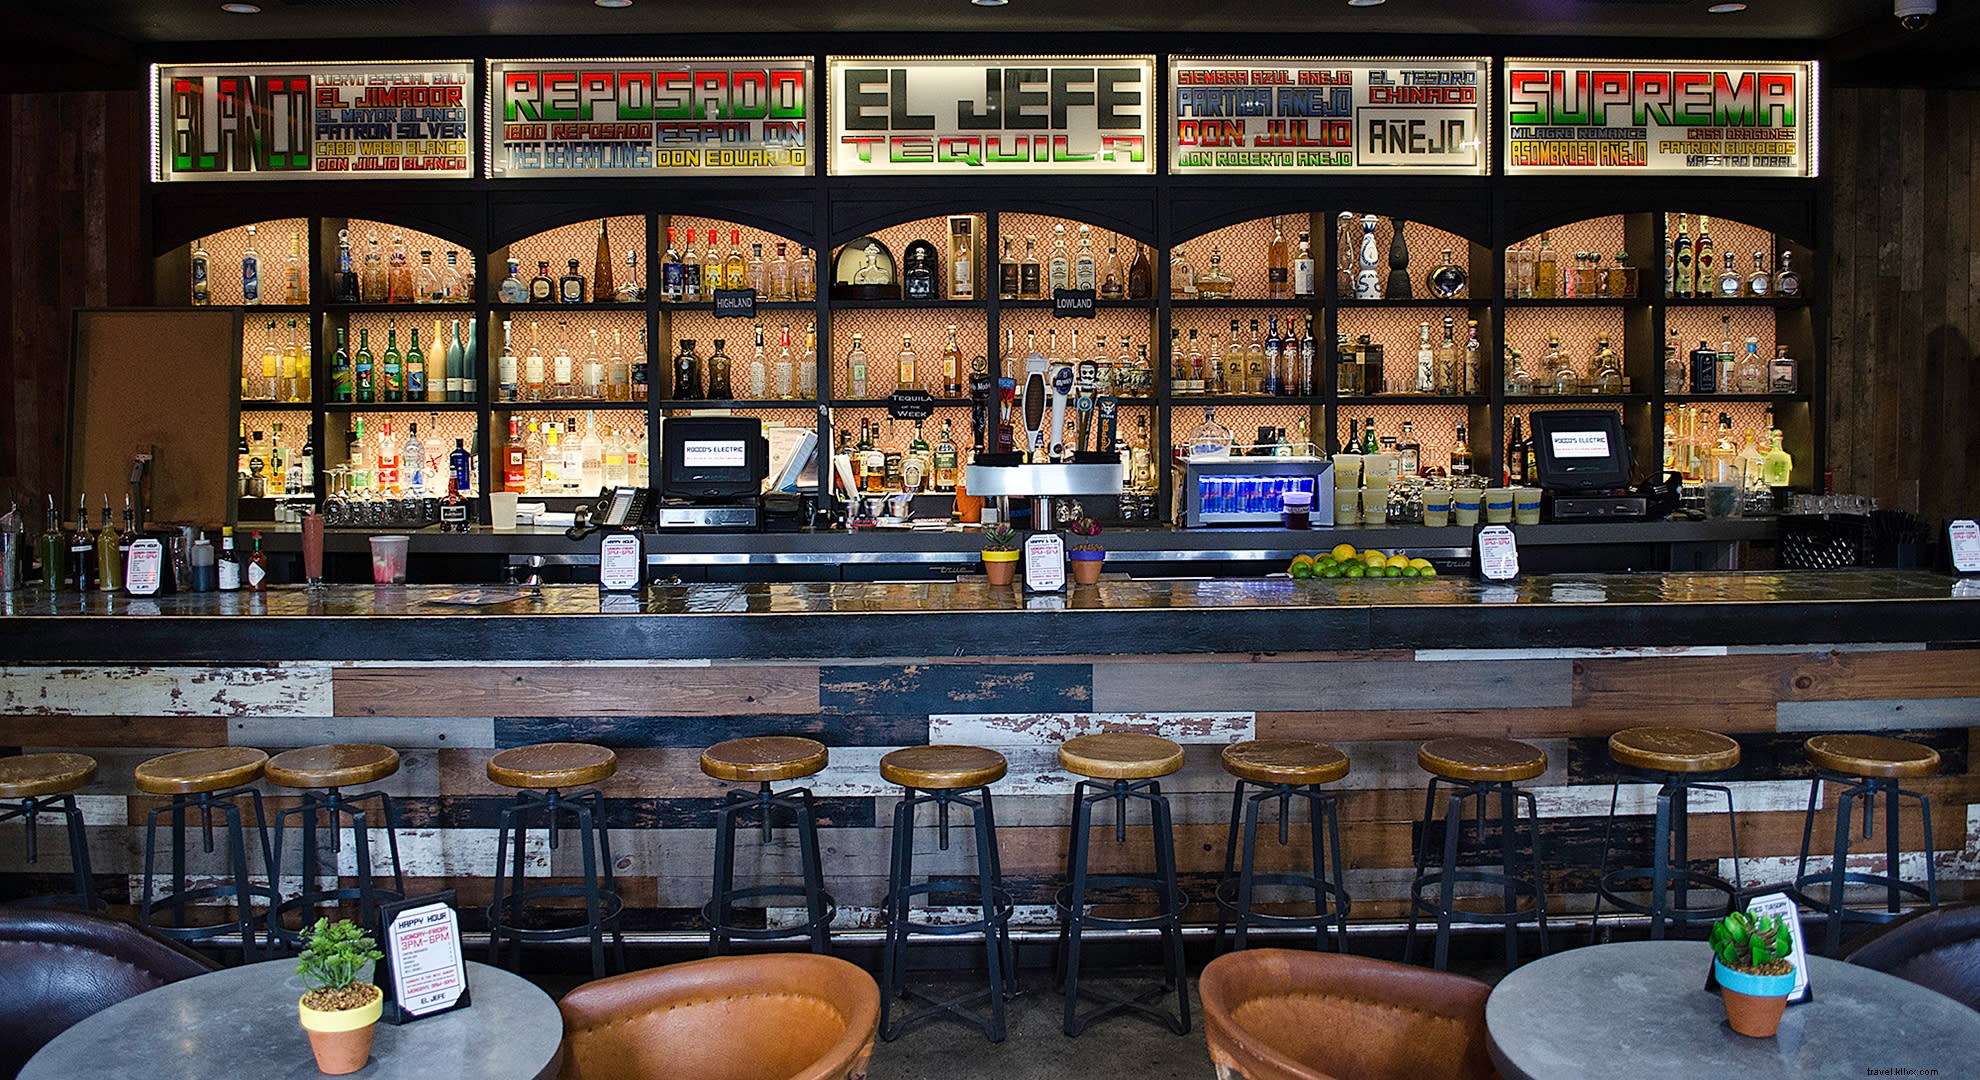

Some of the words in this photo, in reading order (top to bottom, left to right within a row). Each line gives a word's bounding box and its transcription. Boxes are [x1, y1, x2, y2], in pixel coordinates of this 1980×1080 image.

[315, 74, 365, 86] CUERVO
[367, 73, 429, 86] ESPECIAL
[1178, 70, 1249, 86] SIEMBRA
[1251, 70, 1296, 86] AZUL
[1298, 70, 1352, 85] AÑEJO
[1369, 70, 1396, 85] EL
[1399, 70, 1477, 85] TESORO
[315, 87, 349, 108] EL
[355, 86, 464, 108] JIMADOR
[503, 70, 806, 121] REPOSADO
[844, 69, 936, 130] EL
[957, 68, 1141, 130] JEFE
[1177, 87, 1273, 117] PARTIDA
[1369, 87, 1477, 104] CHINACO
[1510, 70, 1796, 127] SUPREMA
[172, 75, 312, 171] BLANCO
[315, 108, 338, 122] EL
[341, 108, 397, 122] MAYOR
[400, 107, 466, 121] BLANCO
[315, 123, 393, 140] PATRON
[397, 122, 466, 139] SILVER
[504, 122, 547, 140] 1800
[551, 122, 652, 140] REPOSADO
[1177, 119, 1246, 147] DON
[1254, 119, 1353, 147] JULIO
[1369, 119, 1465, 154] AÑEJO
[1511, 127, 1575, 140] MILAGRO
[1577, 127, 1647, 140] ROMANCE
[1687, 128, 1723, 140] CASA
[1726, 128, 1796, 140] DRAGONES
[315, 141, 356, 156] CABO
[359, 141, 403, 155] WABO
[406, 140, 466, 155] BLANCO
[503, 141, 541, 169] TRES
[841, 135, 1145, 166] TEQUILA
[1511, 141, 1597, 166] ASOMBROSO
[1600, 141, 1648, 166] AÑEJO
[1659, 141, 1721, 154] PATRON
[1725, 141, 1796, 155] BURDEOS
[316, 157, 349, 171] DON
[352, 157, 400, 170] JULIO
[402, 156, 467, 170] BLANCO
[656, 149, 701, 167] DON
[705, 148, 806, 167] EDUARDO
[1179, 151, 1213, 167] DON
[1216, 151, 1294, 167] ROBERTO
[1296, 151, 1353, 166] AÑEJO
[1687, 155, 1750, 167] MAESTRO
[716, 297, 753, 308] HIGHLAND
[1056, 298, 1092, 308] LOWLAND
[892, 394, 933, 402] TEQUILA
[897, 410, 927, 418] WEEK
[399, 918, 424, 929] HAPPY
[427, 912, 447, 923] HOUR
[401, 932, 450, 951] 3PM-6PM
[430, 993, 446, 1002] JEFE
